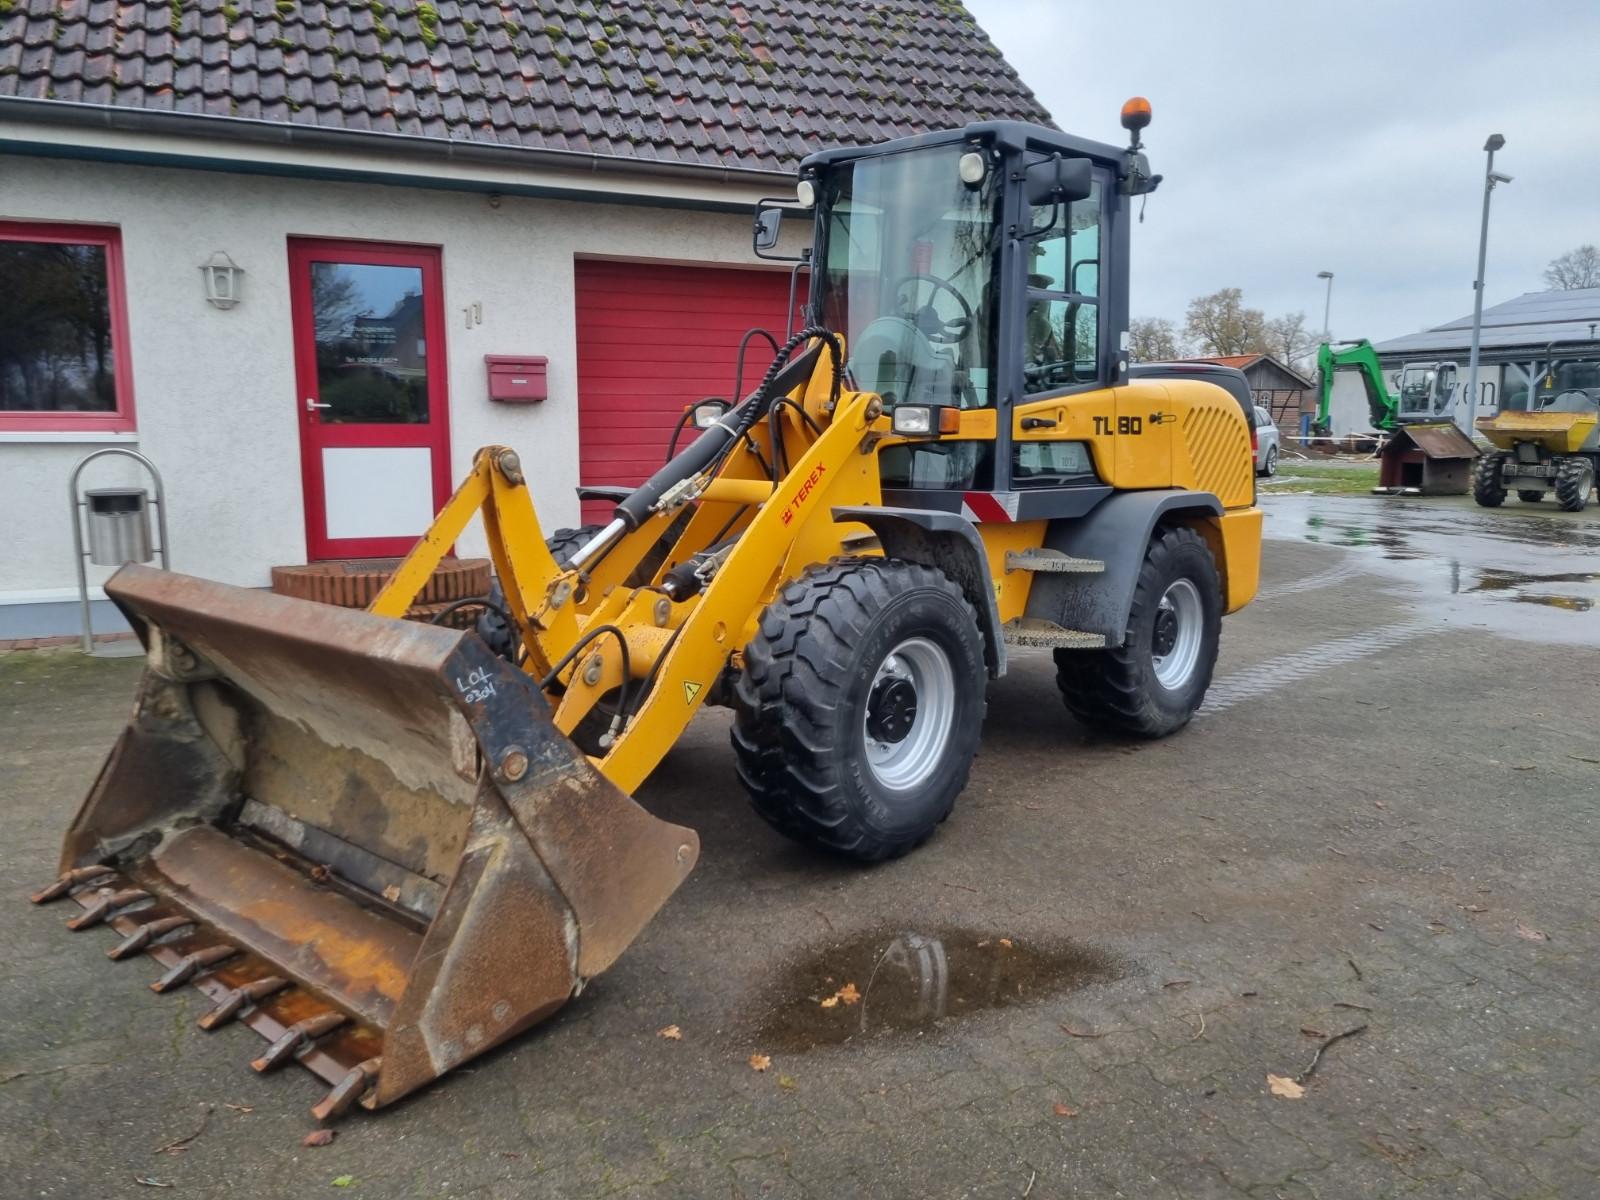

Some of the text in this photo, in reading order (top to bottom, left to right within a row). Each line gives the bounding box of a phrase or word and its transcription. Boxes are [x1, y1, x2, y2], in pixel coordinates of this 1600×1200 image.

[1093, 416, 1142, 436] TL 80
[792, 461, 826, 508] TEREX
